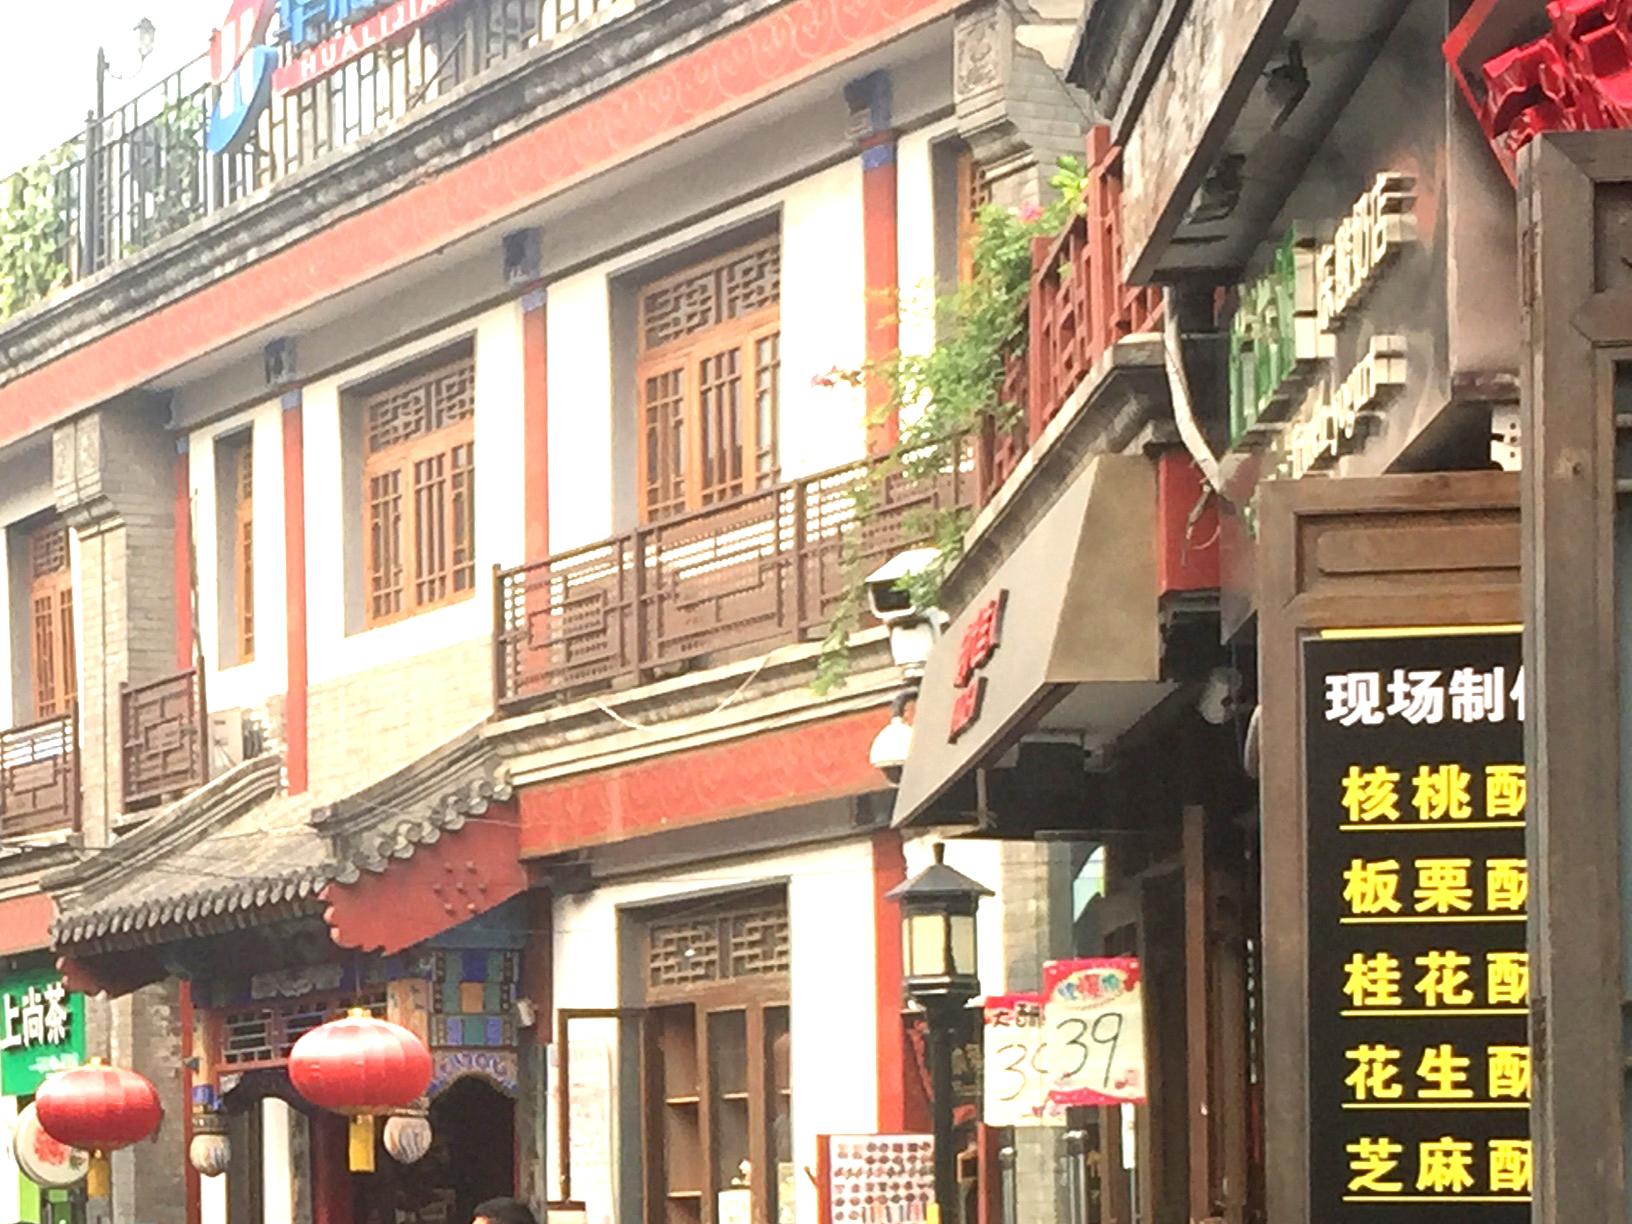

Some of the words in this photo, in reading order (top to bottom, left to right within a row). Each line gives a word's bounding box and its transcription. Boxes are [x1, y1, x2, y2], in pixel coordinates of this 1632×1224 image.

[1341, 763, 1527, 822] 核桃酥
[1342, 858, 1529, 914] 板栗酥
[1343, 950, 1531, 1007] 桂花酥
[0, 980, 70, 1050] 上尚茶
[1056, 1012, 1124, 1088] 39
[1344, 1043, 1532, 1099] 花生酥
[1346, 1136, 1533, 1193] 芝麻酥
